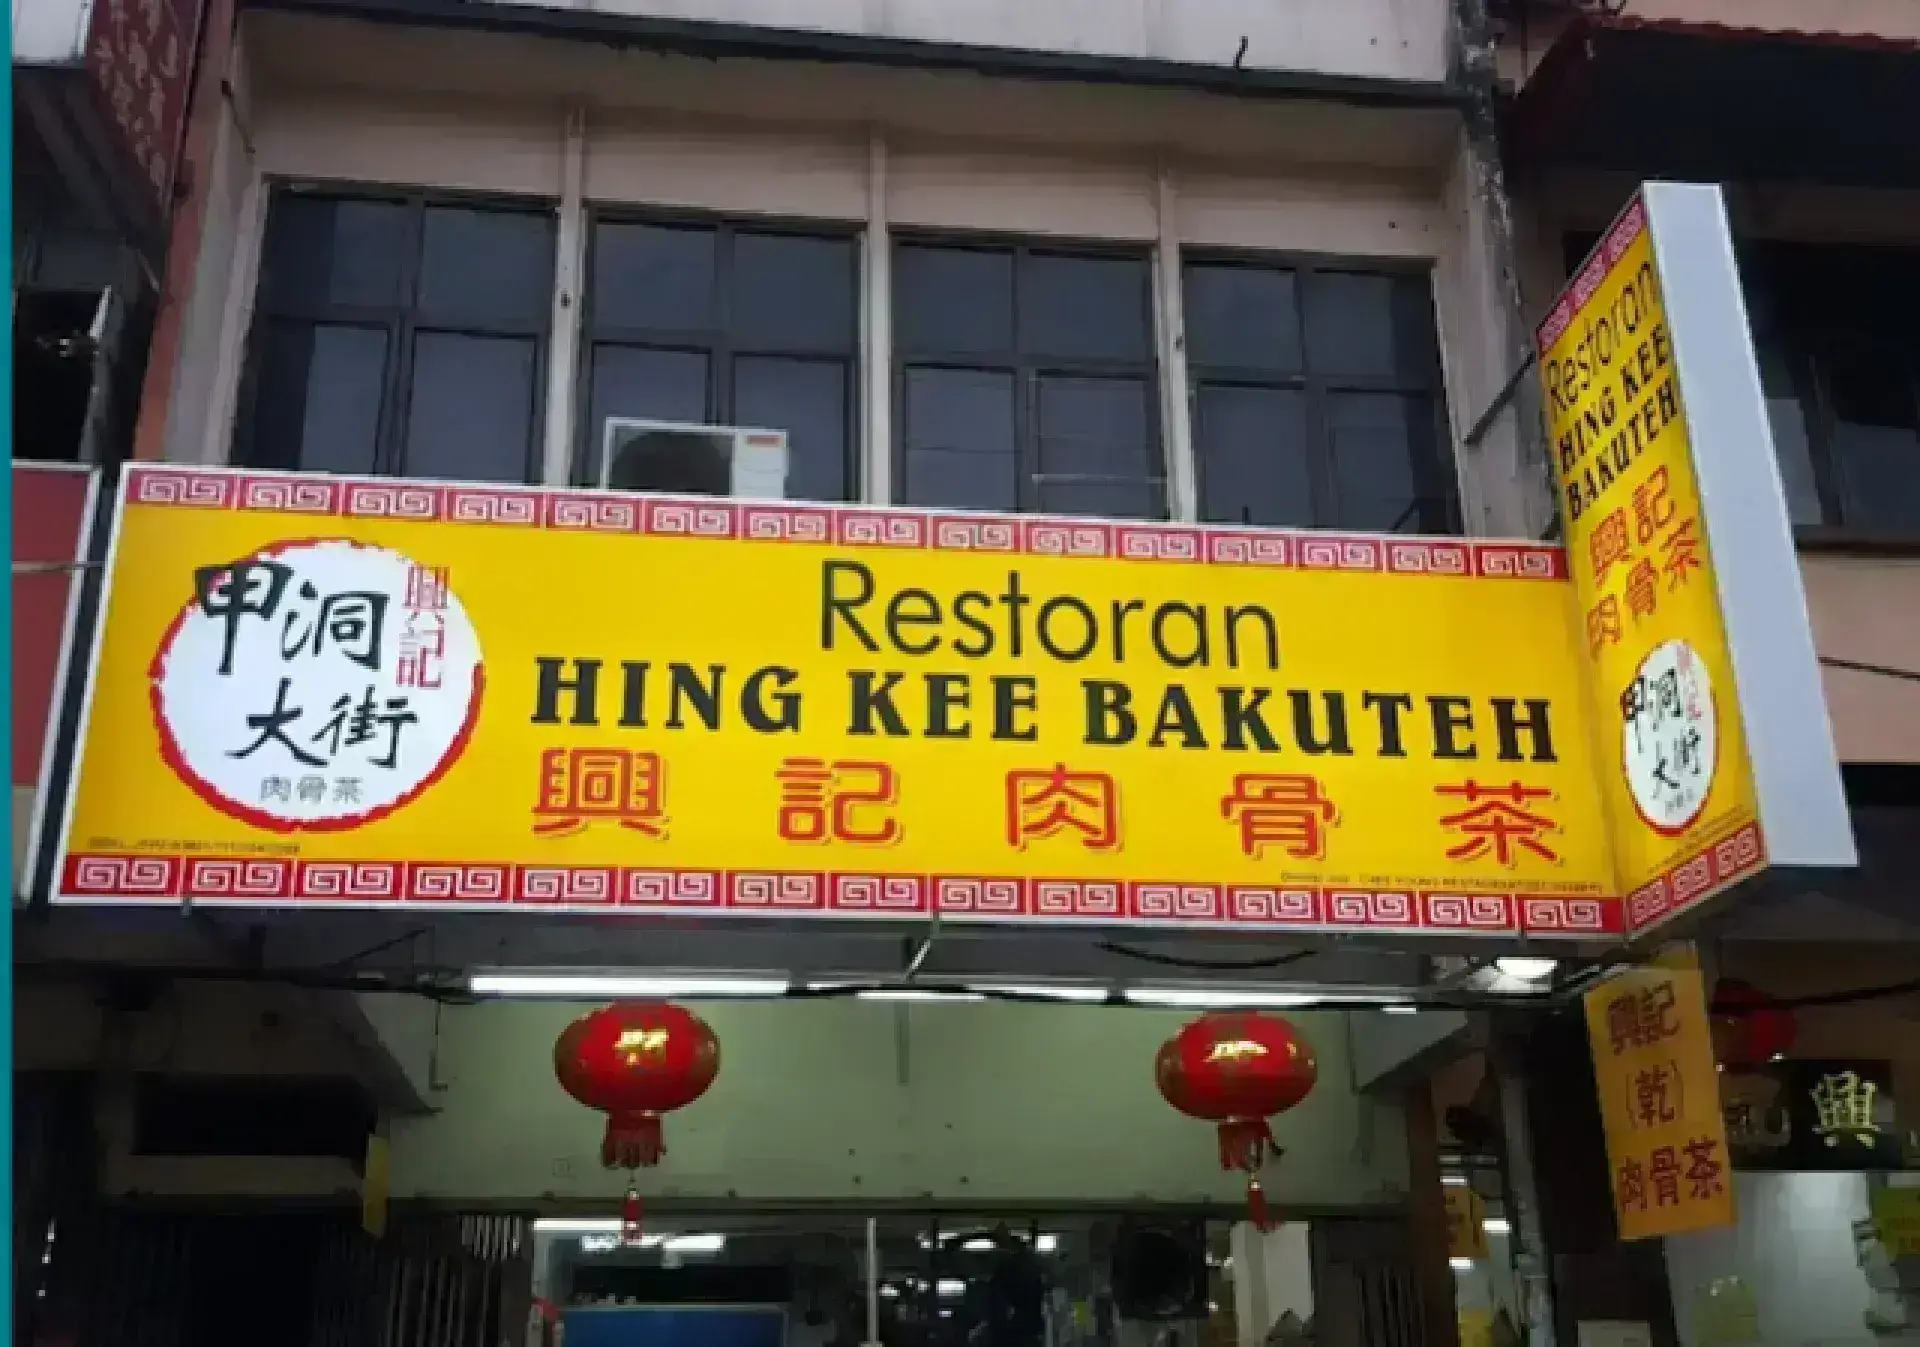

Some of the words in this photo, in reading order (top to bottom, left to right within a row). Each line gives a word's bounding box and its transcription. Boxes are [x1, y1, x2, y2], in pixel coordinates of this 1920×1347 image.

[1558, 386, 1617, 475] HING
[1620, 323, 1670, 403] KEE
[1565, 377, 1678, 522] BAKUTEH
[195, 562, 390, 675] 甲洞
[821, 558, 1280, 670] Restoran
[225, 677, 419, 769] 大街
[530, 656, 803, 733] HING
[845, 670, 1039, 742] KEE
[1080, 678, 1559, 763] BAKUTEH
[1617, 1133, 1725, 1213] 肉骨茶
